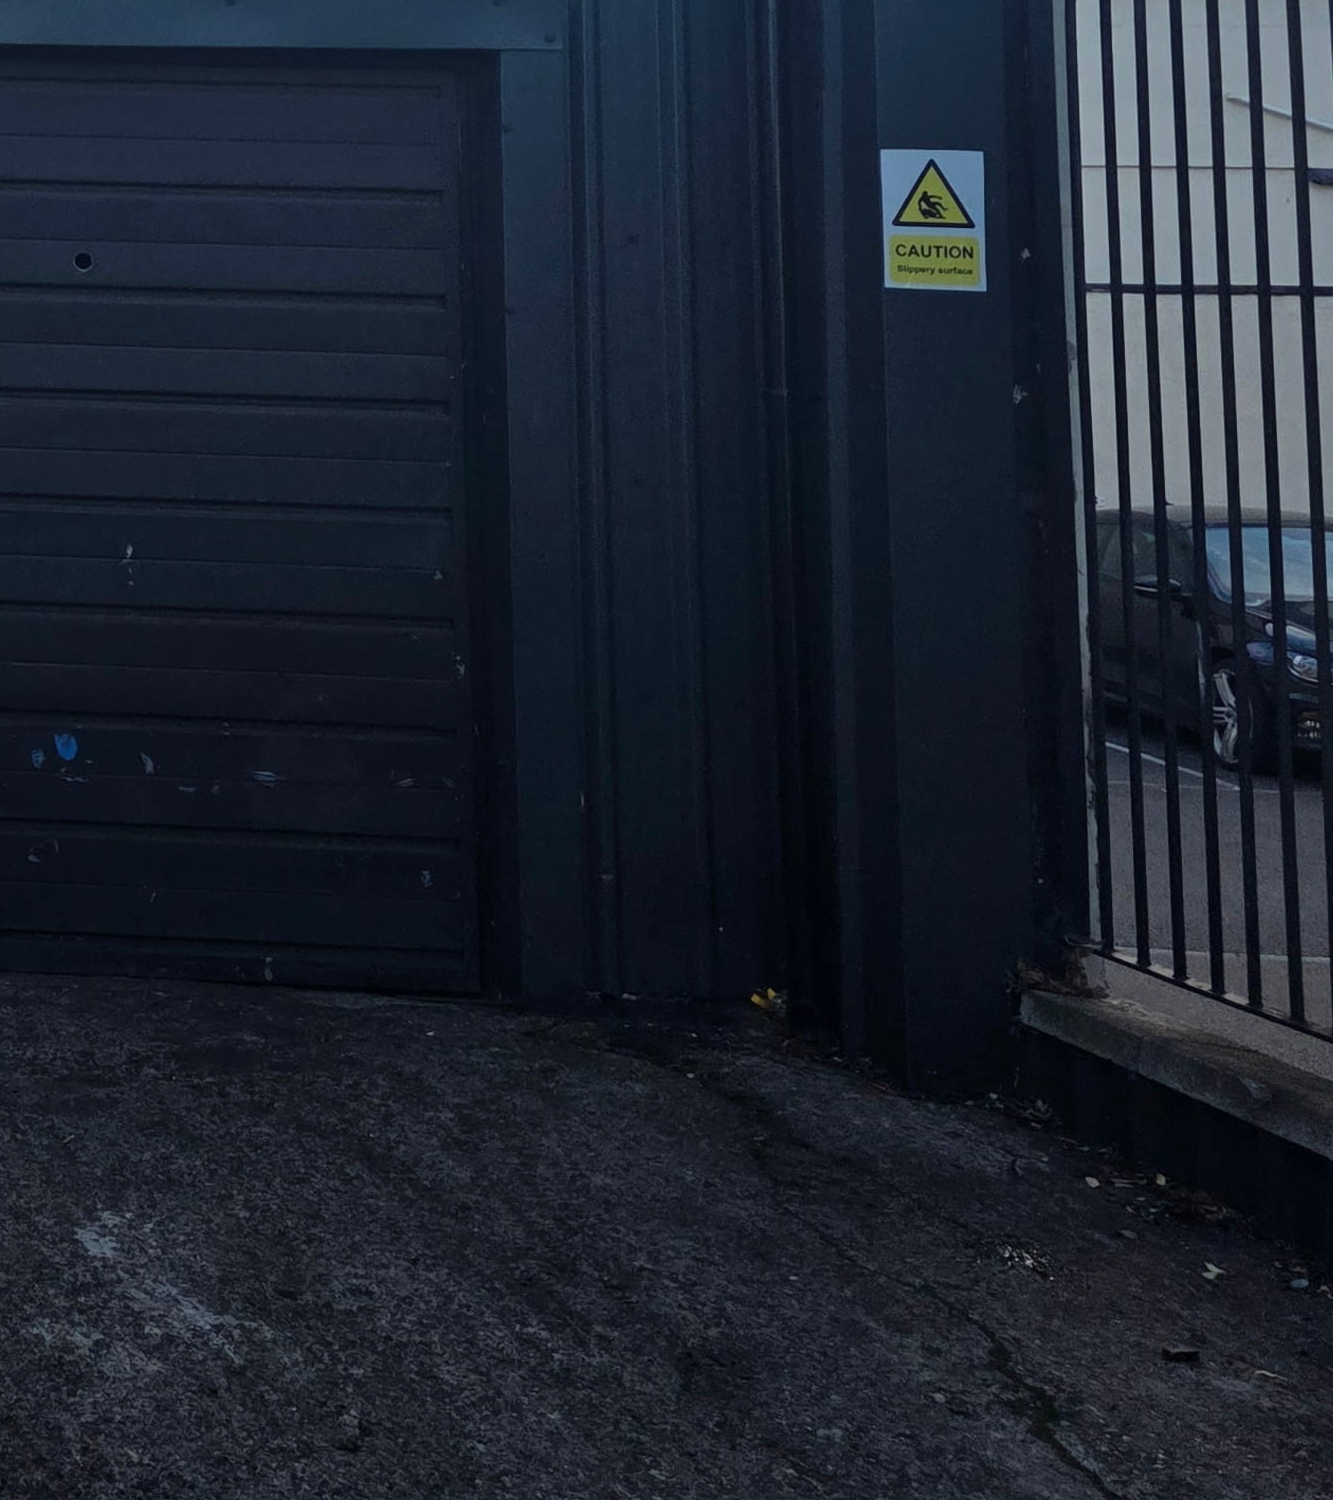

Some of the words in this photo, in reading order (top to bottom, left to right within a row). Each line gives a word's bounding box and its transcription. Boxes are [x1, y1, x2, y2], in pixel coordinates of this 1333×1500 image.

[895, 243, 974, 259] CAUTION
[897, 264, 936, 275] Slippery
[938, 266, 974, 275] surface
